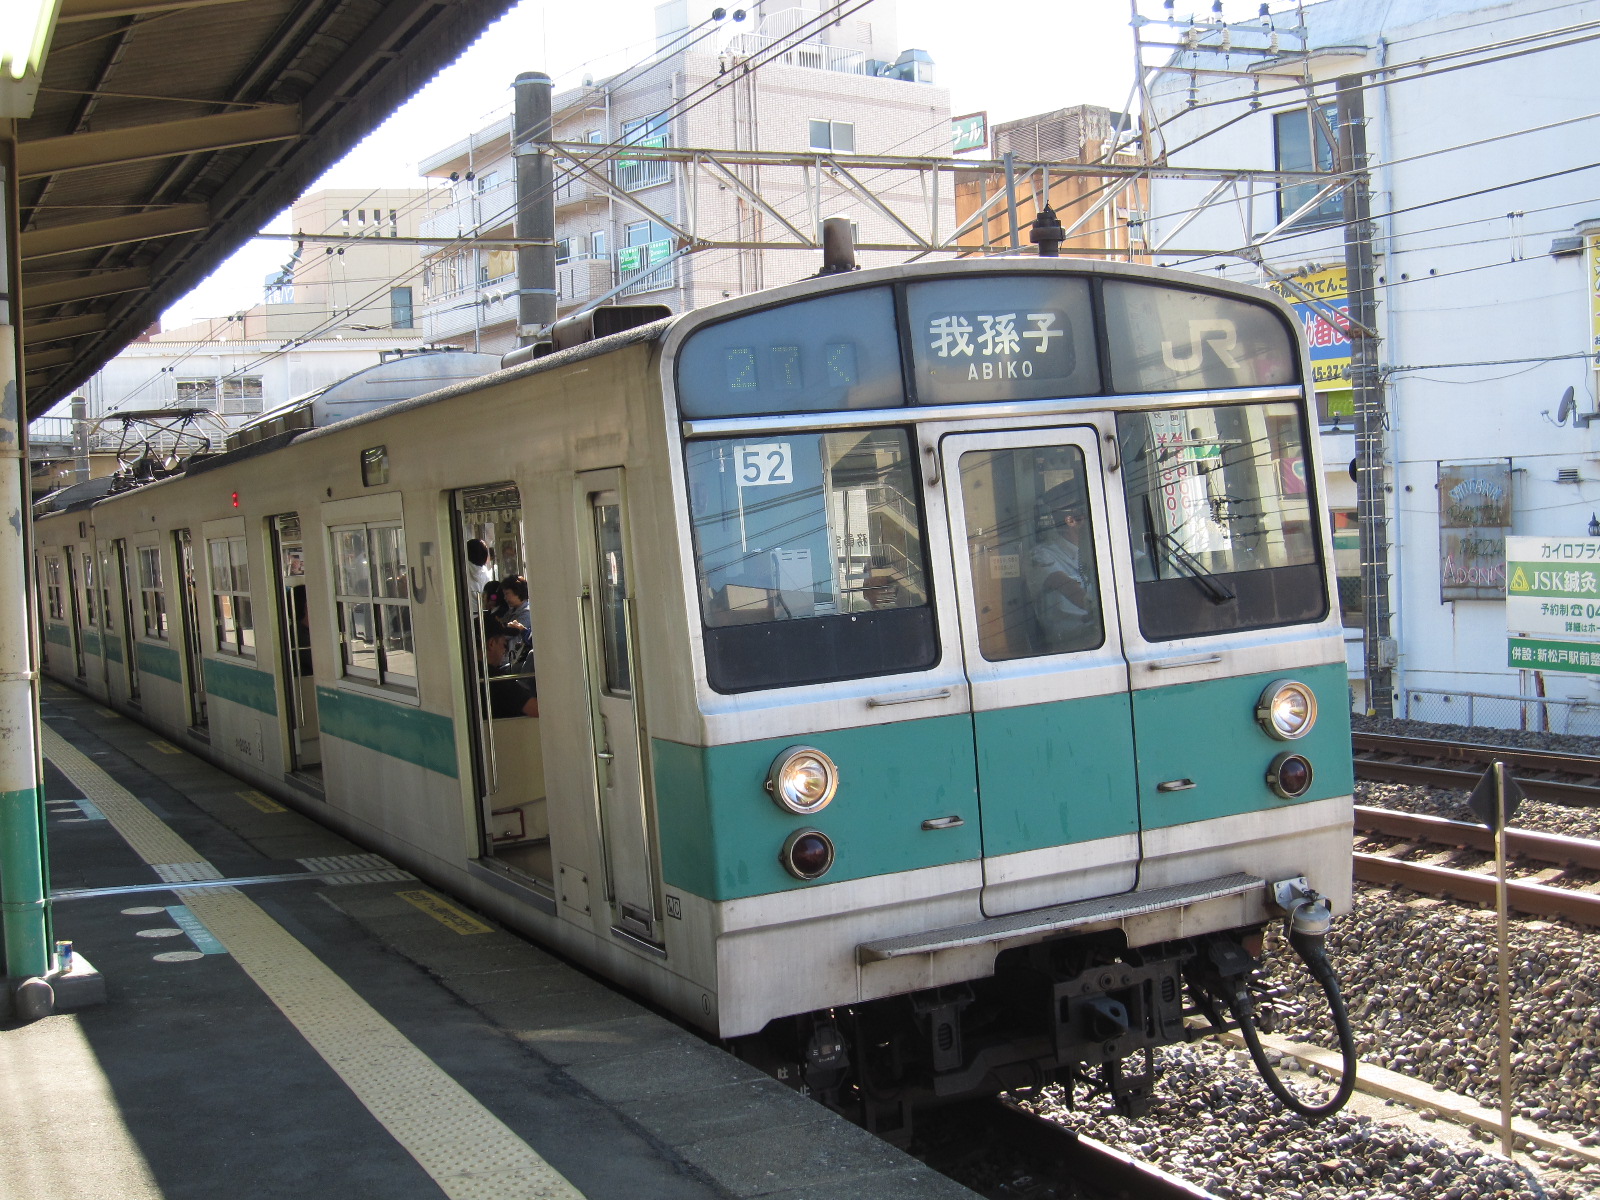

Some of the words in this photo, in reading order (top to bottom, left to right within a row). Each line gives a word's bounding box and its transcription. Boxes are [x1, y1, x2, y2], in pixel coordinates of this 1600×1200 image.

[929, 313, 1064, 357] 我孫子
[1161, 319, 1240, 371] JR
[968, 361, 1033, 381] ABIKO
[742, 451, 786, 482] 52
